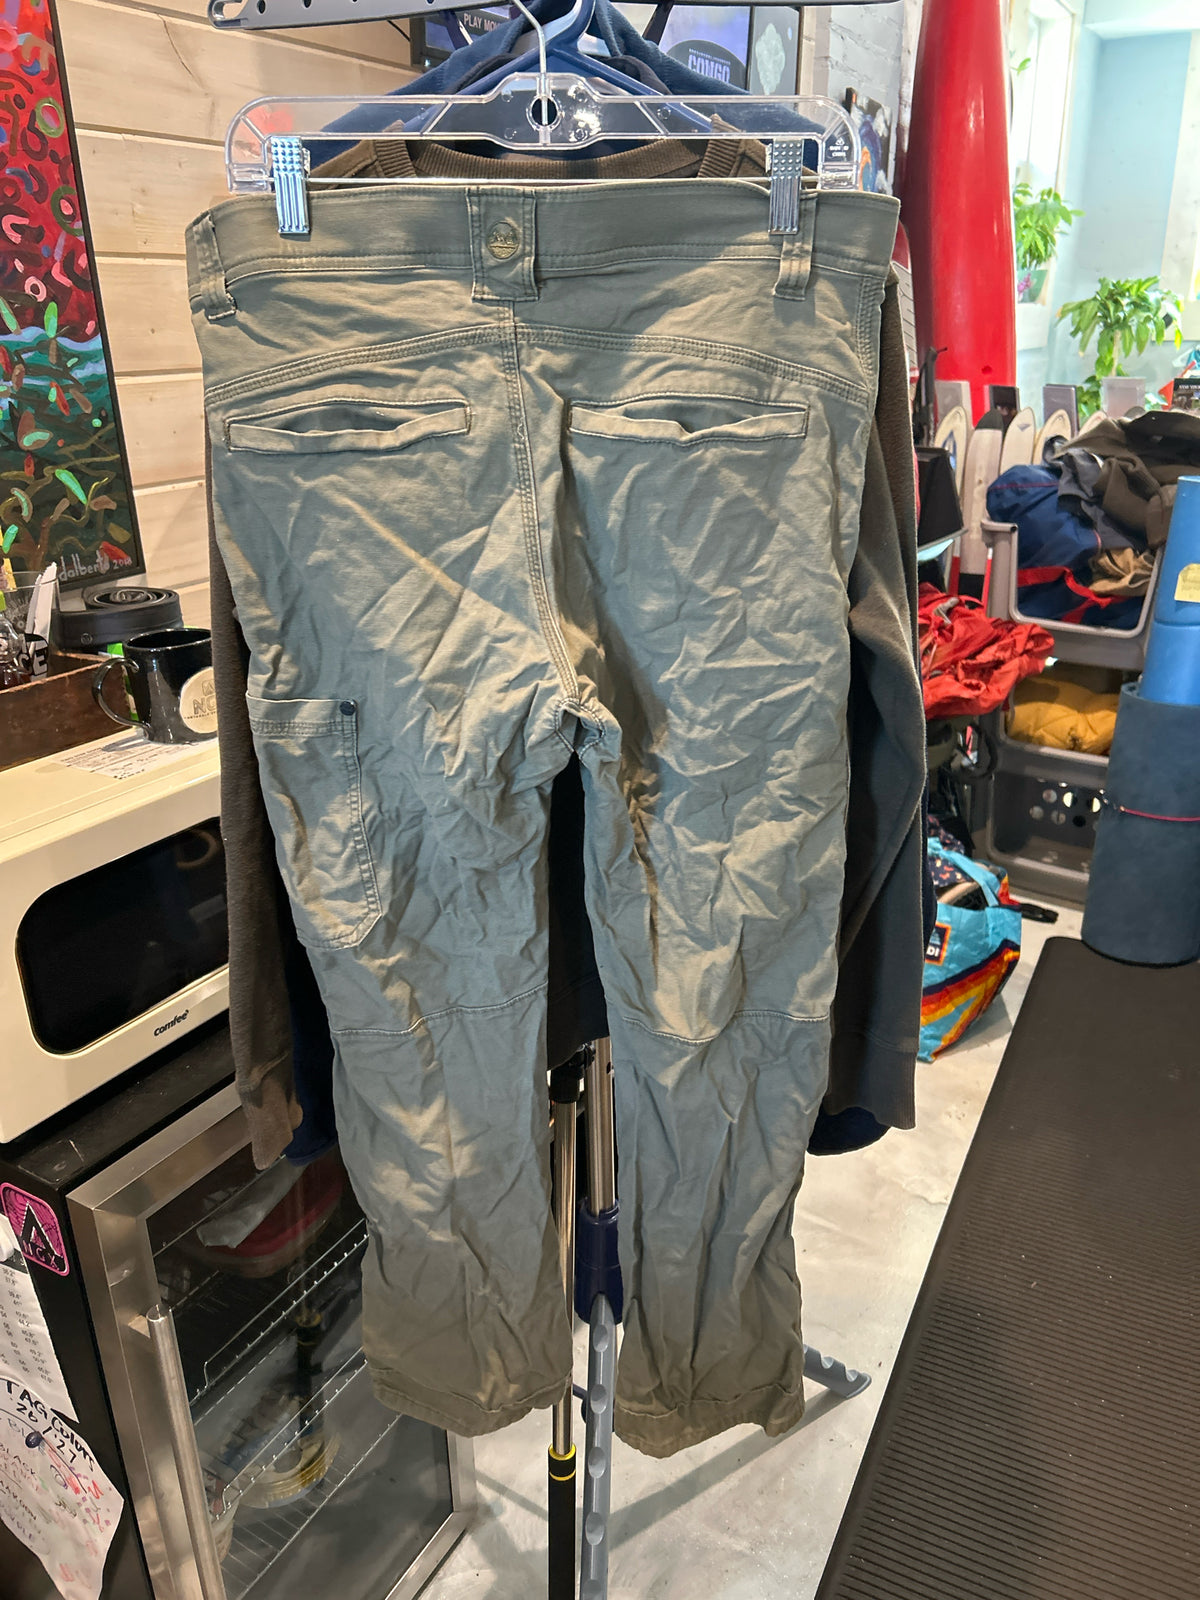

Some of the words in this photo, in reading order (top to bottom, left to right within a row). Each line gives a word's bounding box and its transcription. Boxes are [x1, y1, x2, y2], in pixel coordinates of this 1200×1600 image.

[463, 13, 483, 29] PLAY
[687, 54, 731, 83] CONGO
[4, 1379, 48, 1420] TAG
